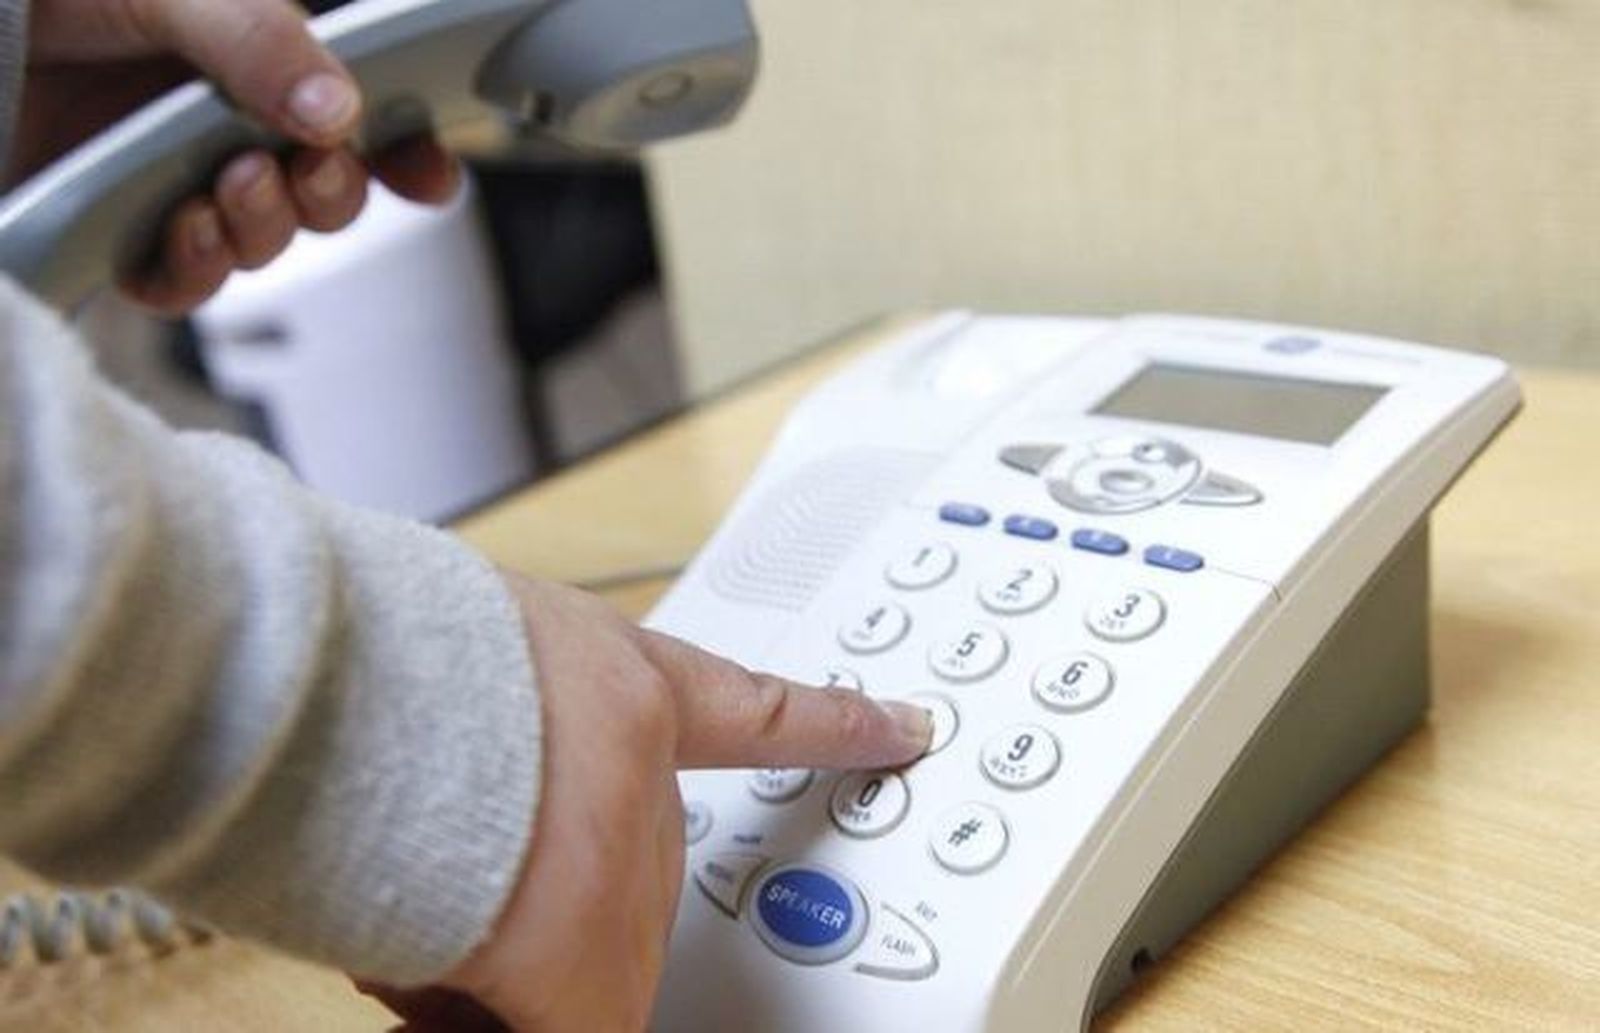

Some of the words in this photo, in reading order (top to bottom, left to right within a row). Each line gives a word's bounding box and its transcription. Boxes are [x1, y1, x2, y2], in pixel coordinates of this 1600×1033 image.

[1004, 568, 1033, 592] 2
[864, 606, 886, 629] 4
[1113, 593, 1141, 618] 3
[955, 631, 982, 657] 5
[1061, 661, 1089, 686] 6
[1007, 734, 1034, 761] 9
[857, 778, 883, 807] 0
[947, 818, 982, 847] #
[766, 883, 846, 929] SPEAKER
